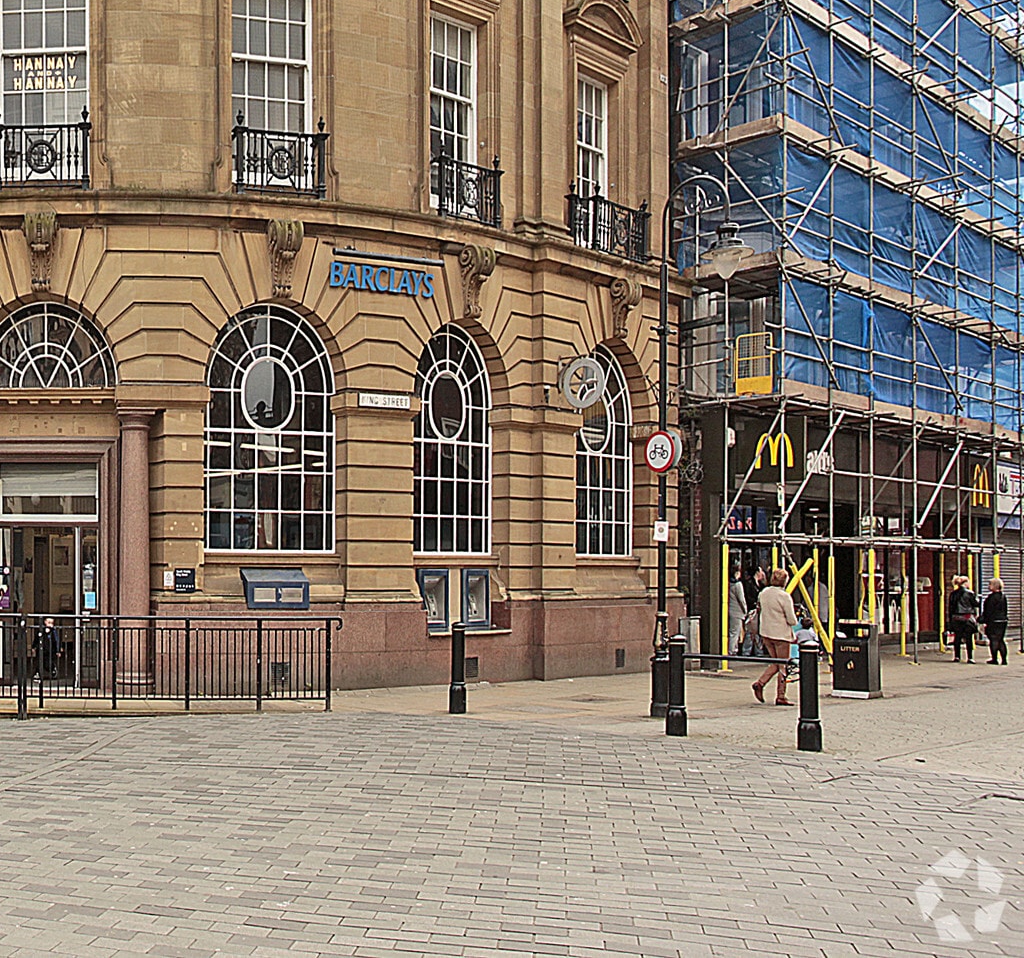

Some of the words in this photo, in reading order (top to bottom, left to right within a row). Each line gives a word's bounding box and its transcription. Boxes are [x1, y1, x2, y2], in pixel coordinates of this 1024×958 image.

[13, 57, 75, 71] HANNAY
[13, 76, 77, 90] HANNAY
[329, 262, 434, 298] BARCLAYS
[382, 397, 408, 407] STREET
